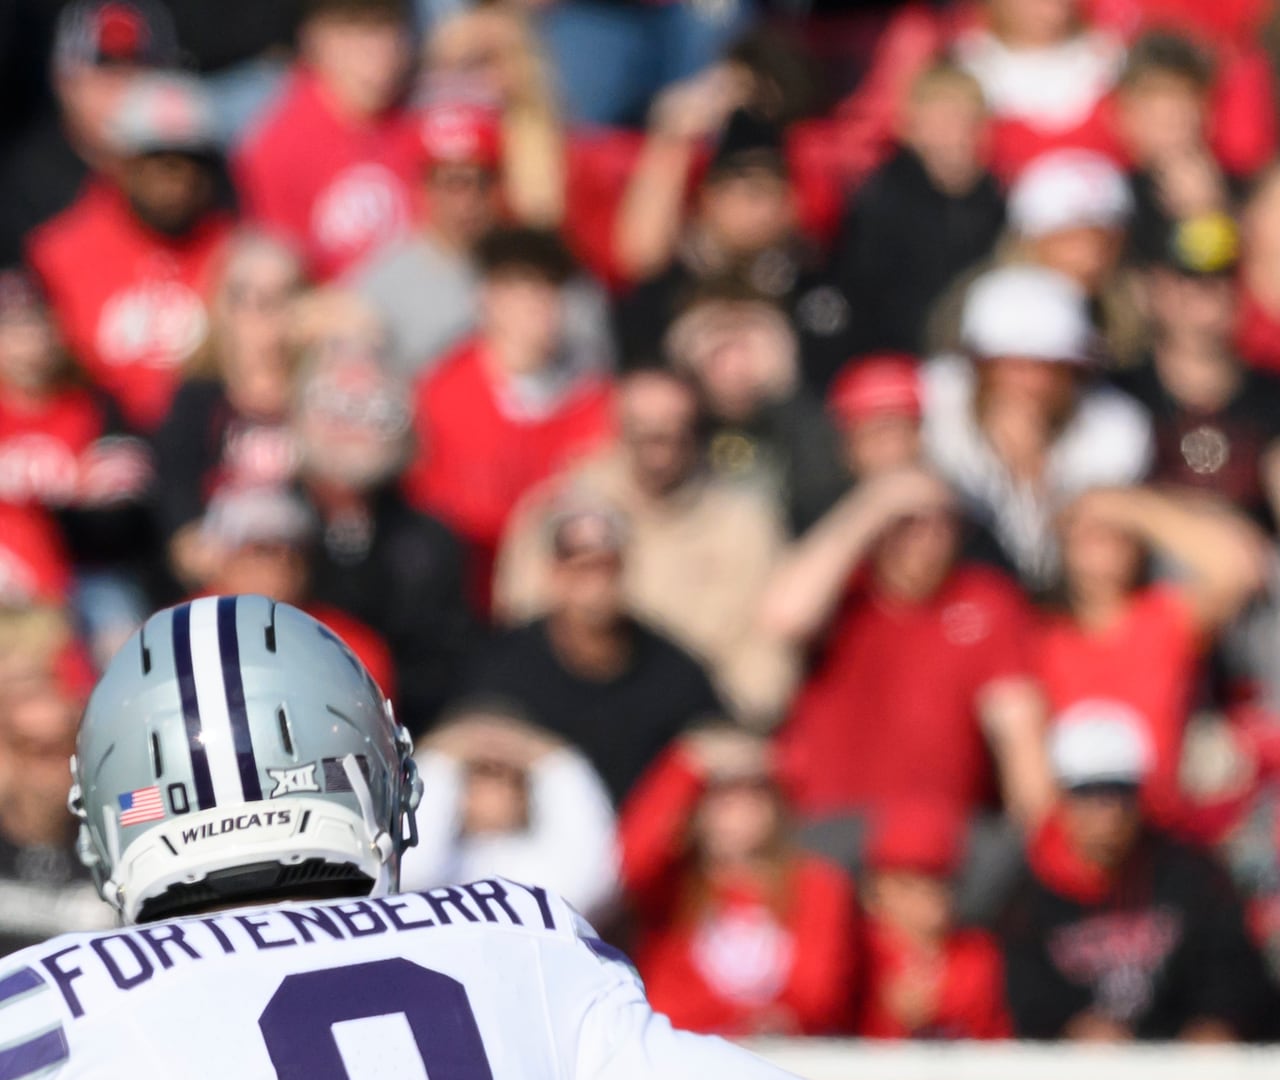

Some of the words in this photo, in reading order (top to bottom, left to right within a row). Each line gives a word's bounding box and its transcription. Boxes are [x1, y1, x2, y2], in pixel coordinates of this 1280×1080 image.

[167, 782, 190, 815] 0
[182, 809, 291, 845] WILDCATS
[40, 878, 557, 1019] FORTENBERRY
